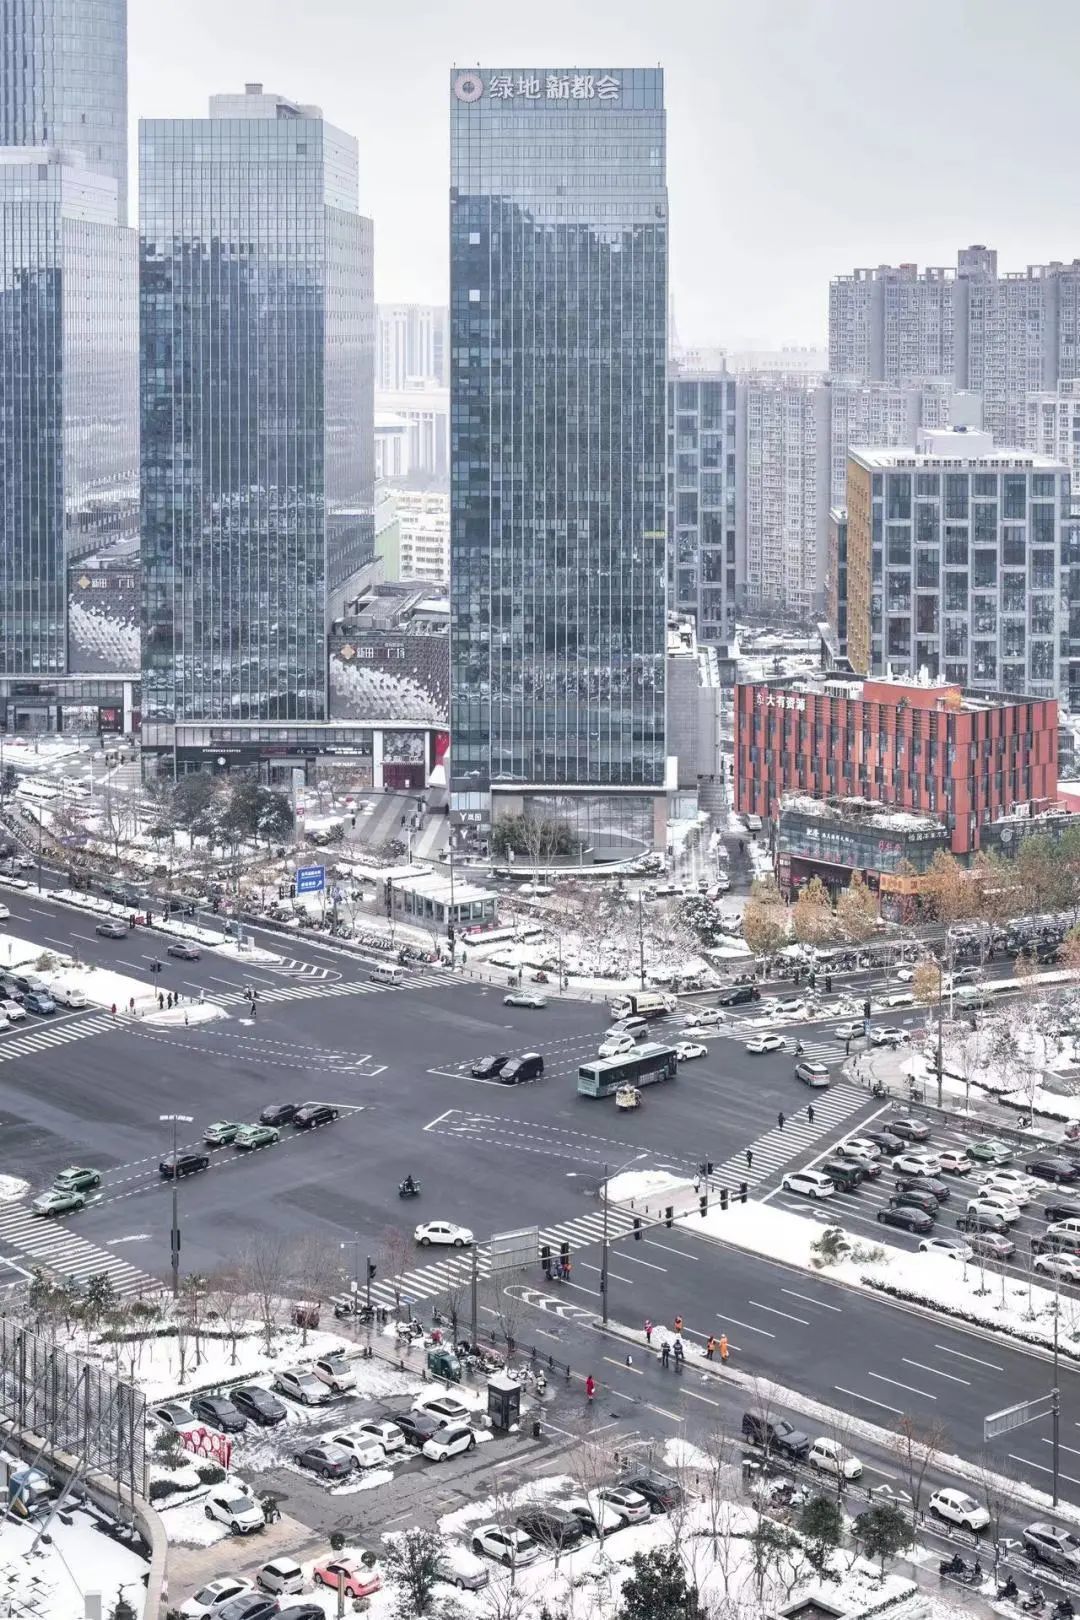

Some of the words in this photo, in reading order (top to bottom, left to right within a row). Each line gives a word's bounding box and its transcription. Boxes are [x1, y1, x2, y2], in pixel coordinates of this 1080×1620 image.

[489, 75, 620, 100] 绿地新都会
